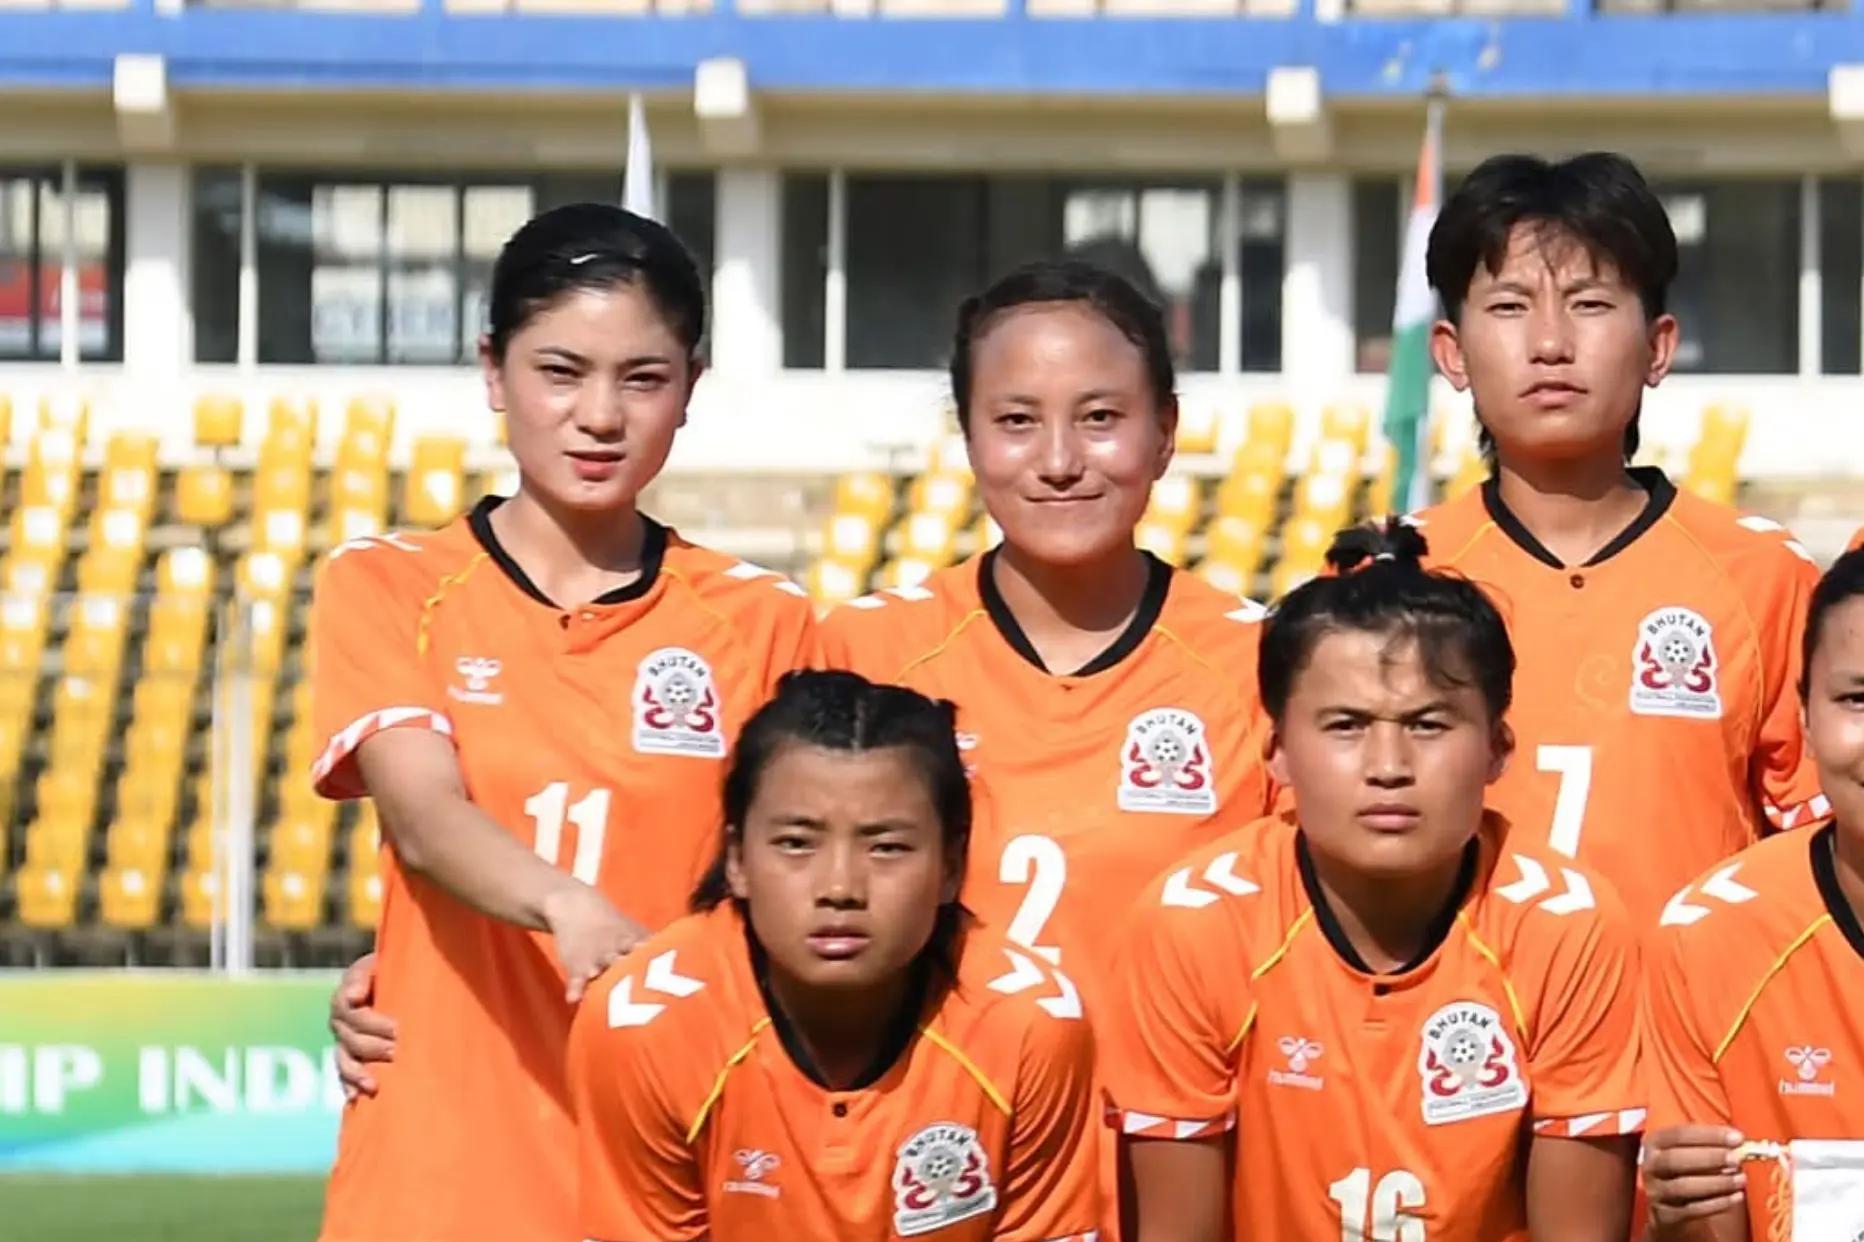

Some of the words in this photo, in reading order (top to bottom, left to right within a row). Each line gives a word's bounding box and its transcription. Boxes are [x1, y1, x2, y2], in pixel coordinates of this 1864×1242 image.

[1648, 614, 1705, 637] BHUTAN
[1136, 714, 1198, 736] BHUTAN
[524, 781, 612, 887] 11
[1537, 745, 1593, 859] 7
[999, 834, 1067, 966] 2
[1428, 1011, 1492, 1040] BHUTAN
[139, 1046, 342, 1113] INDI
